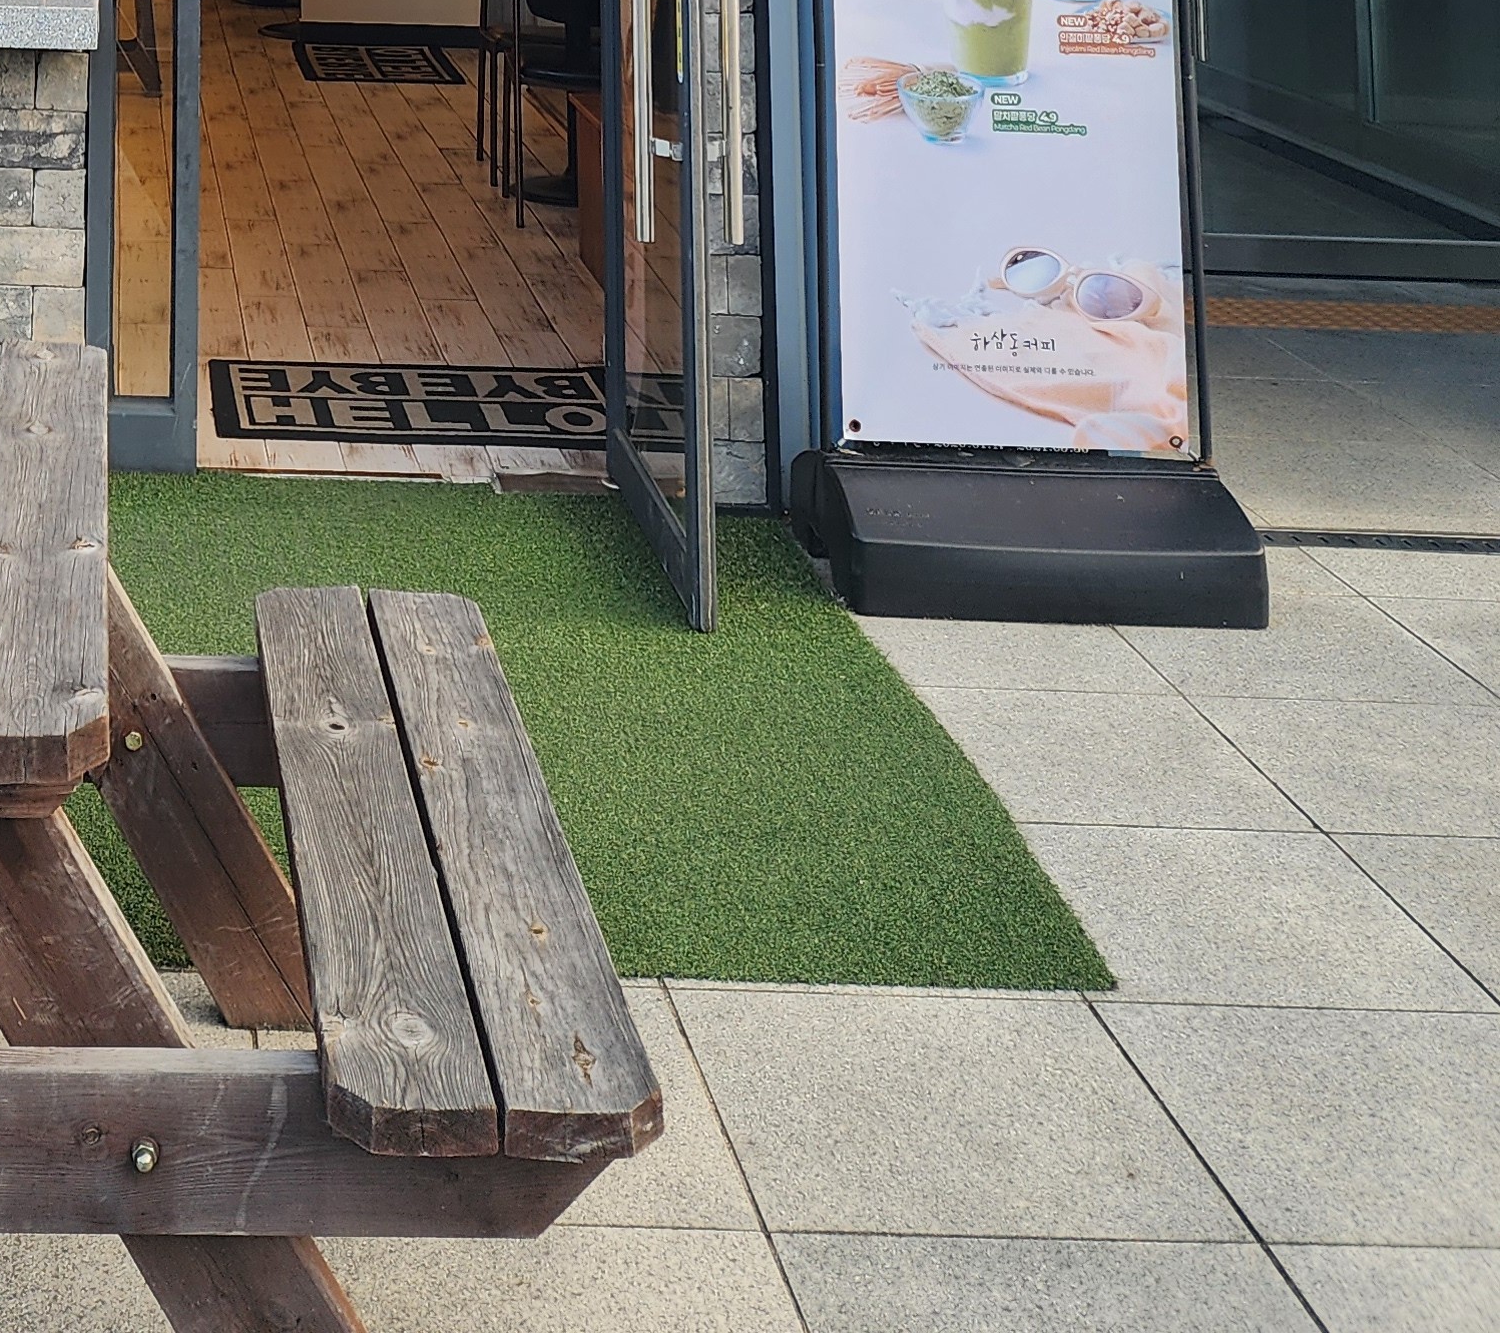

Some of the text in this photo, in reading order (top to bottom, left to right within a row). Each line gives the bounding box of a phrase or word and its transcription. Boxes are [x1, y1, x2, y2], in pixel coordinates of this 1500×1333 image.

[1060, 17, 1085, 26] NEW
[1112, 35, 1130, 43] 4.9
[994, 95, 1018, 104] NEW
[1040, 112, 1057, 122] 4.9
[970, 329, 1056, 357] 하삼동커피
[249, 396, 607, 433] HELLO
